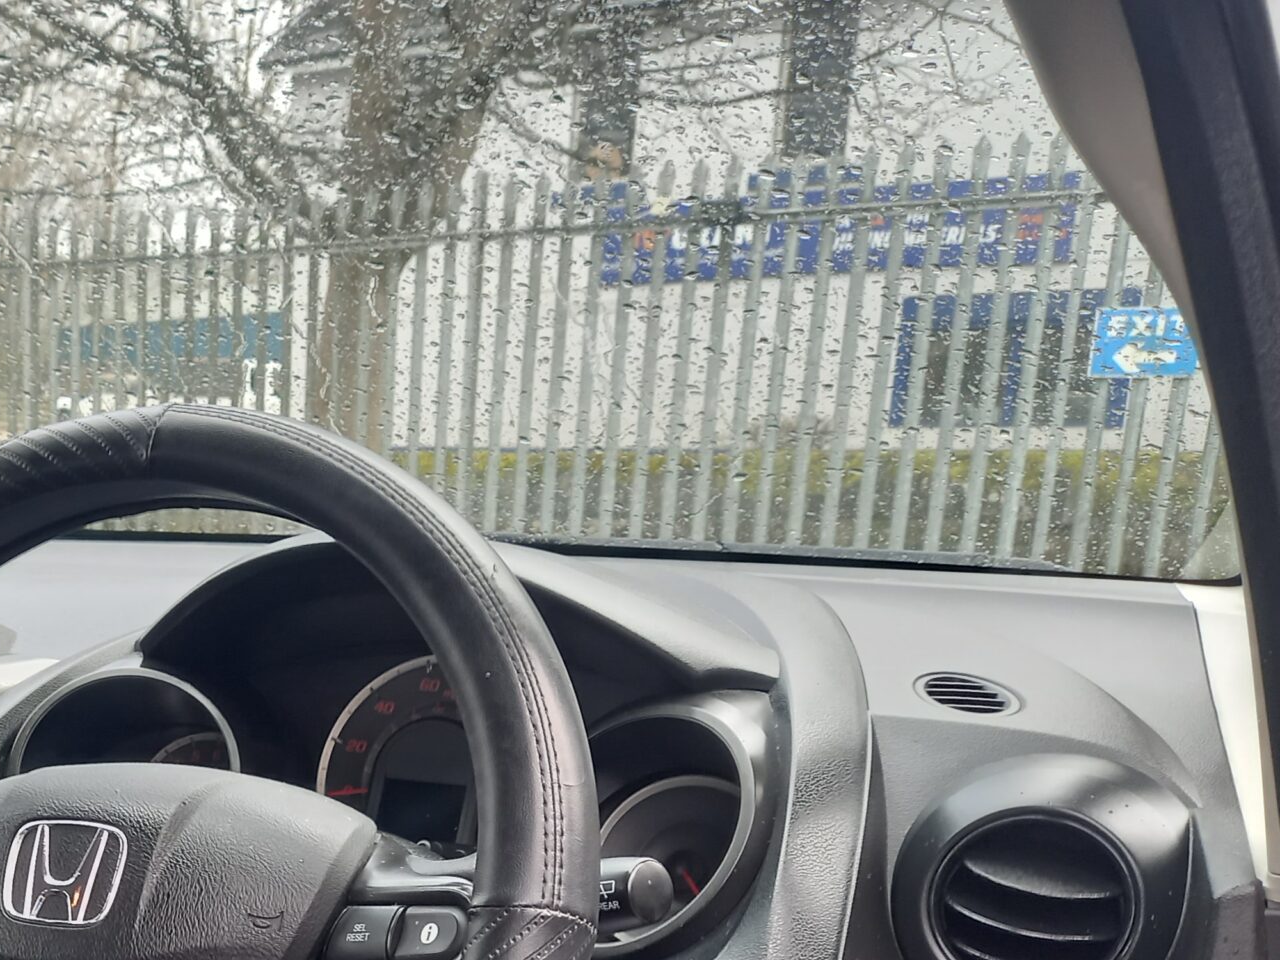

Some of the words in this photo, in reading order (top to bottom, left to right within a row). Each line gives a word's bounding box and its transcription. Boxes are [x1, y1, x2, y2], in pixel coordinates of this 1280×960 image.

[1106, 315, 1185, 337] EXIT
[420, 678, 440, 692] 60
[374, 701, 395, 714] 40
[346, 740, 367, 752] 20
[353, 923, 367, 932] SEL
[346, 932, 370, 942] RESET
